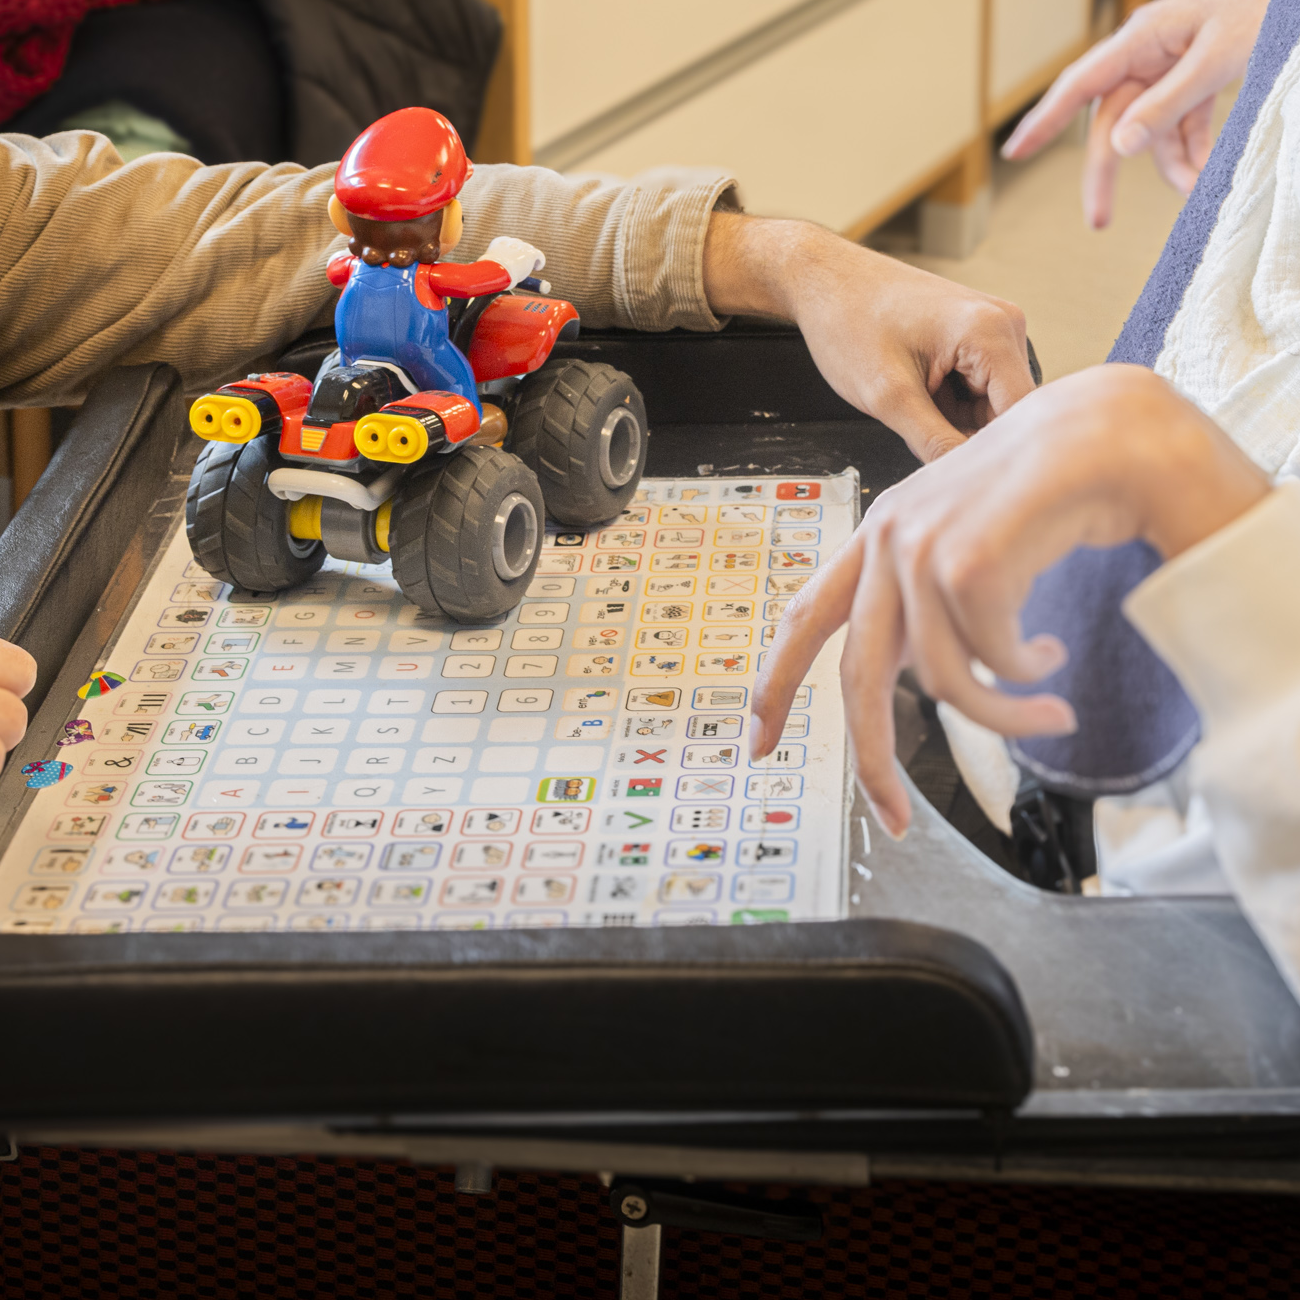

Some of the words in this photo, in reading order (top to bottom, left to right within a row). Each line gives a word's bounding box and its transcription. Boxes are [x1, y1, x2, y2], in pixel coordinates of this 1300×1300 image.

[596, 609, 605, 619] zer-
[344, 637, 365, 645] N
[406, 637, 428, 645] V
[587, 636, 597, 646] ver-
[639, 632, 647, 643] nochmal
[333, 662, 356, 672] M
[396, 663, 418, 671] U
[582, 666, 591, 674] er-
[577, 697, 588, 708] ent-
[695, 693, 704, 703] kaputt
[220, 788, 244, 797] A
[295, 612, 315, 620] G
[567, 727, 581, 737] be-
[366, 756, 389, 764] R
[433, 756, 456, 764] Z
[617, 752, 627, 762] falsch
[686, 752, 694, 762] selbst
[354, 786, 381, 797] Q
